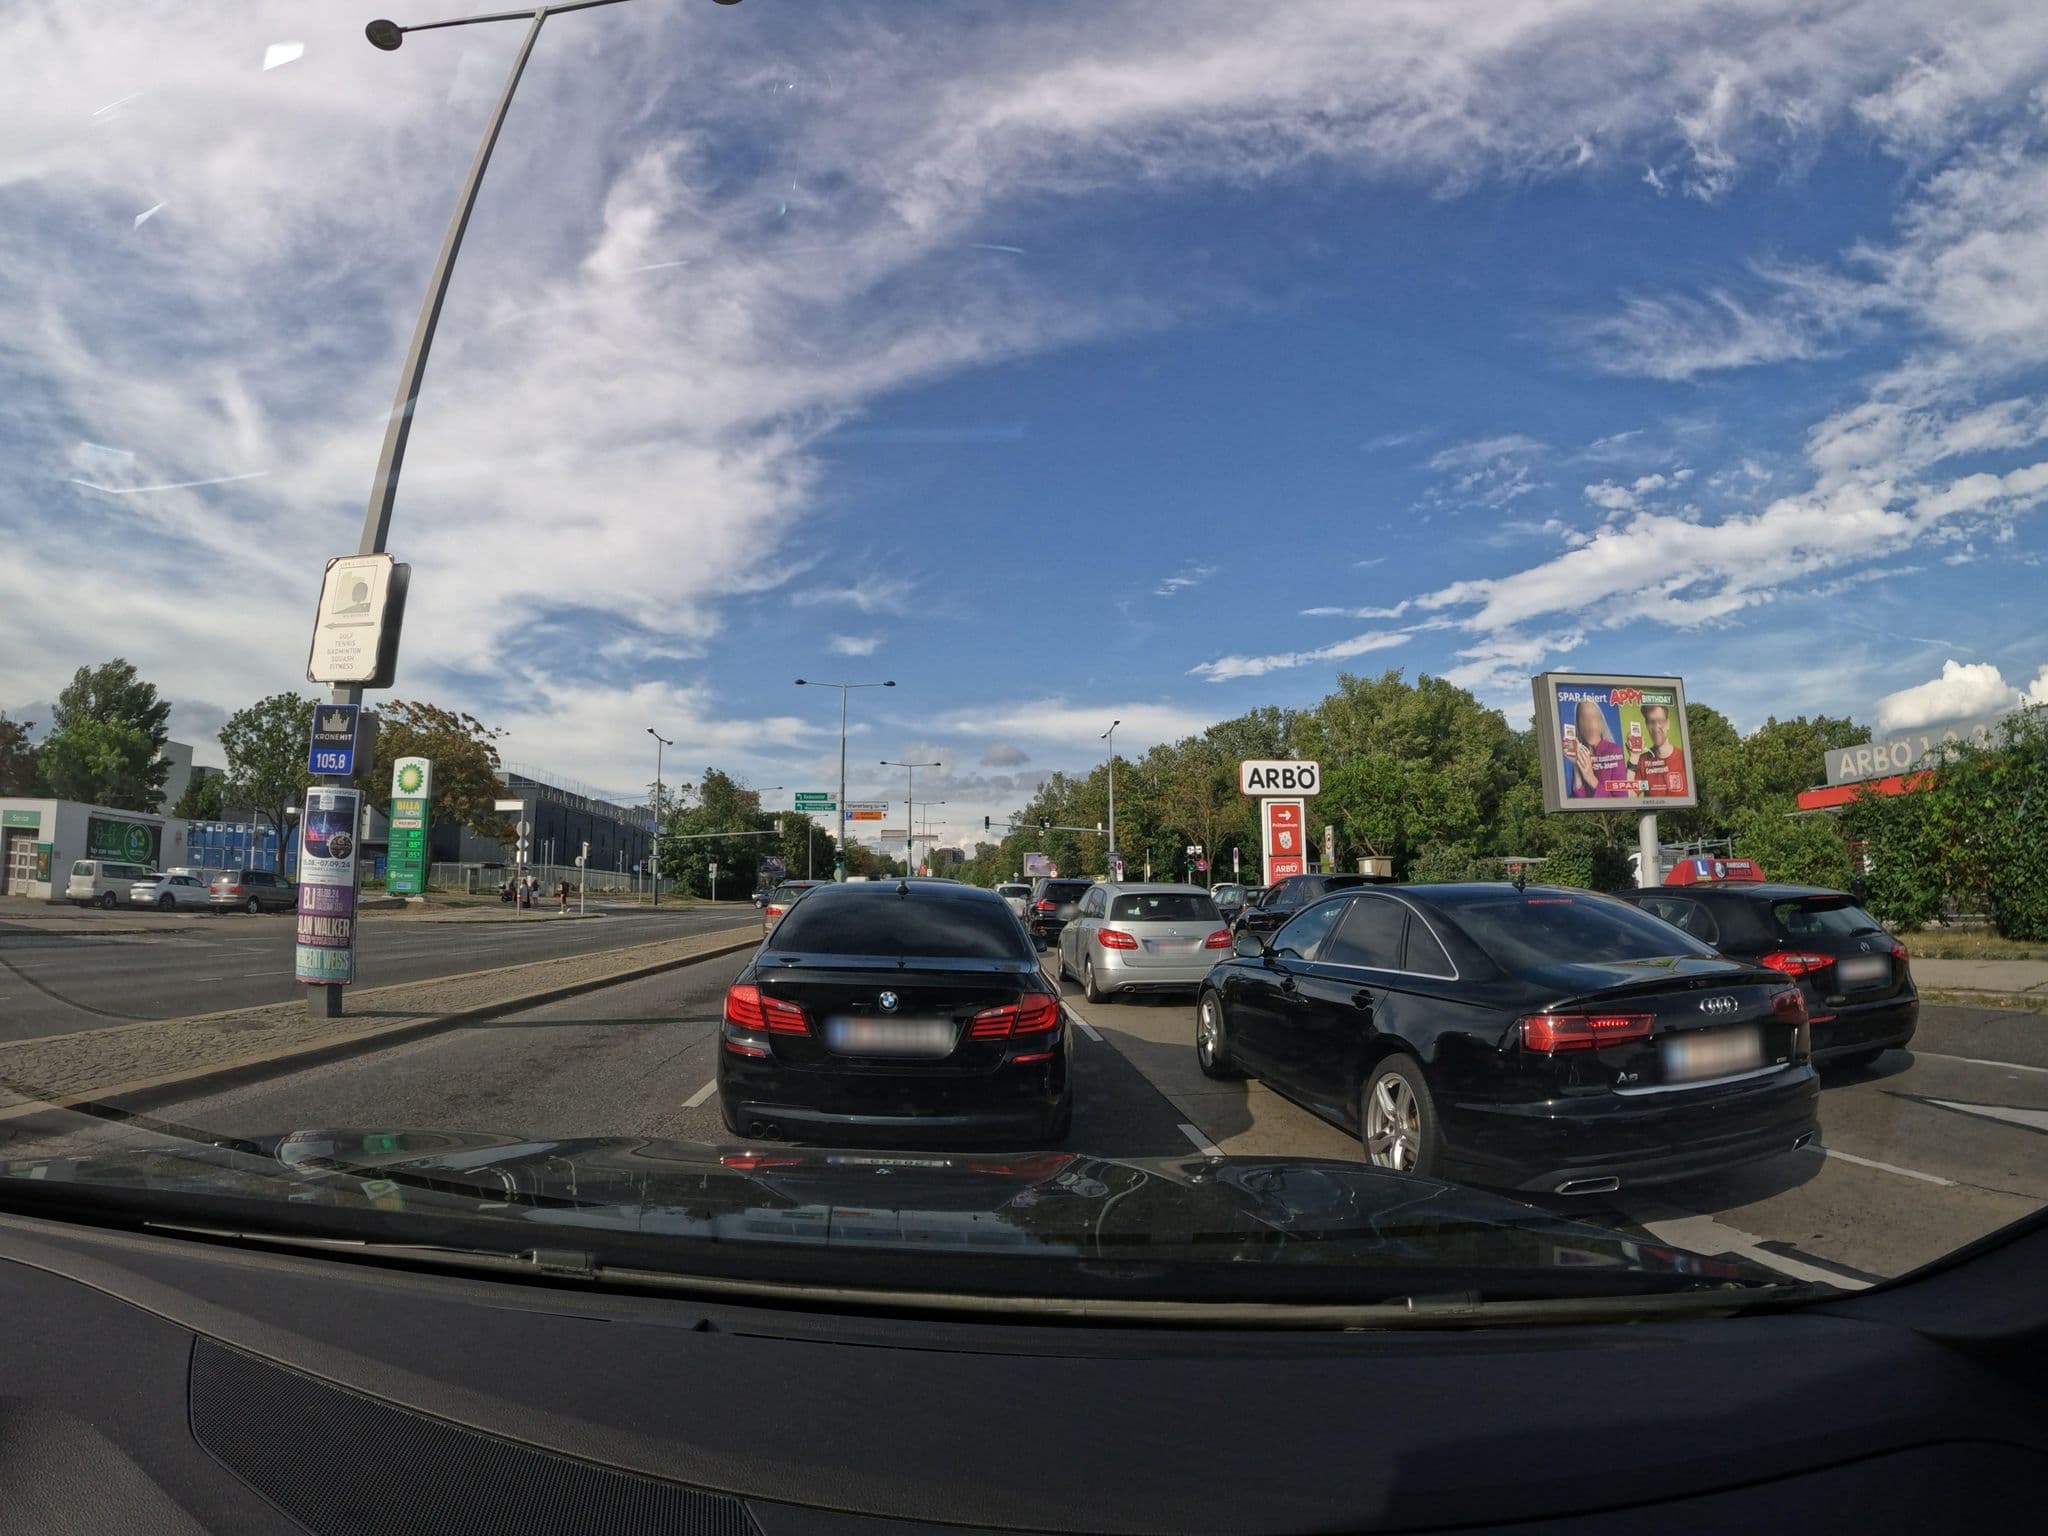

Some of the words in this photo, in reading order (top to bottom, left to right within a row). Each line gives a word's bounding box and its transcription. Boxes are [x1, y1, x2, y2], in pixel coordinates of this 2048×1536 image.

[327, 647, 361, 655] BADMINTON
[329, 662, 354, 670] FITNESS
[1558, 692, 1581, 702] SPAR
[1583, 692, 1607, 703] feiert
[1642, 695, 1672, 703] BIRTHDAY
[314, 733, 353, 741] KRONEHIT
[316, 753, 346, 770] 105,8
[1838, 737, 1913, 779] ARBÖ
[1248, 765, 1316, 789] ARBÖ
[1612, 782, 1639, 790] SPAR
[1275, 862, 1298, 873] ARBÖ
[1697, 861, 1708, 875] L
[314, 917, 350, 937] WALKER
